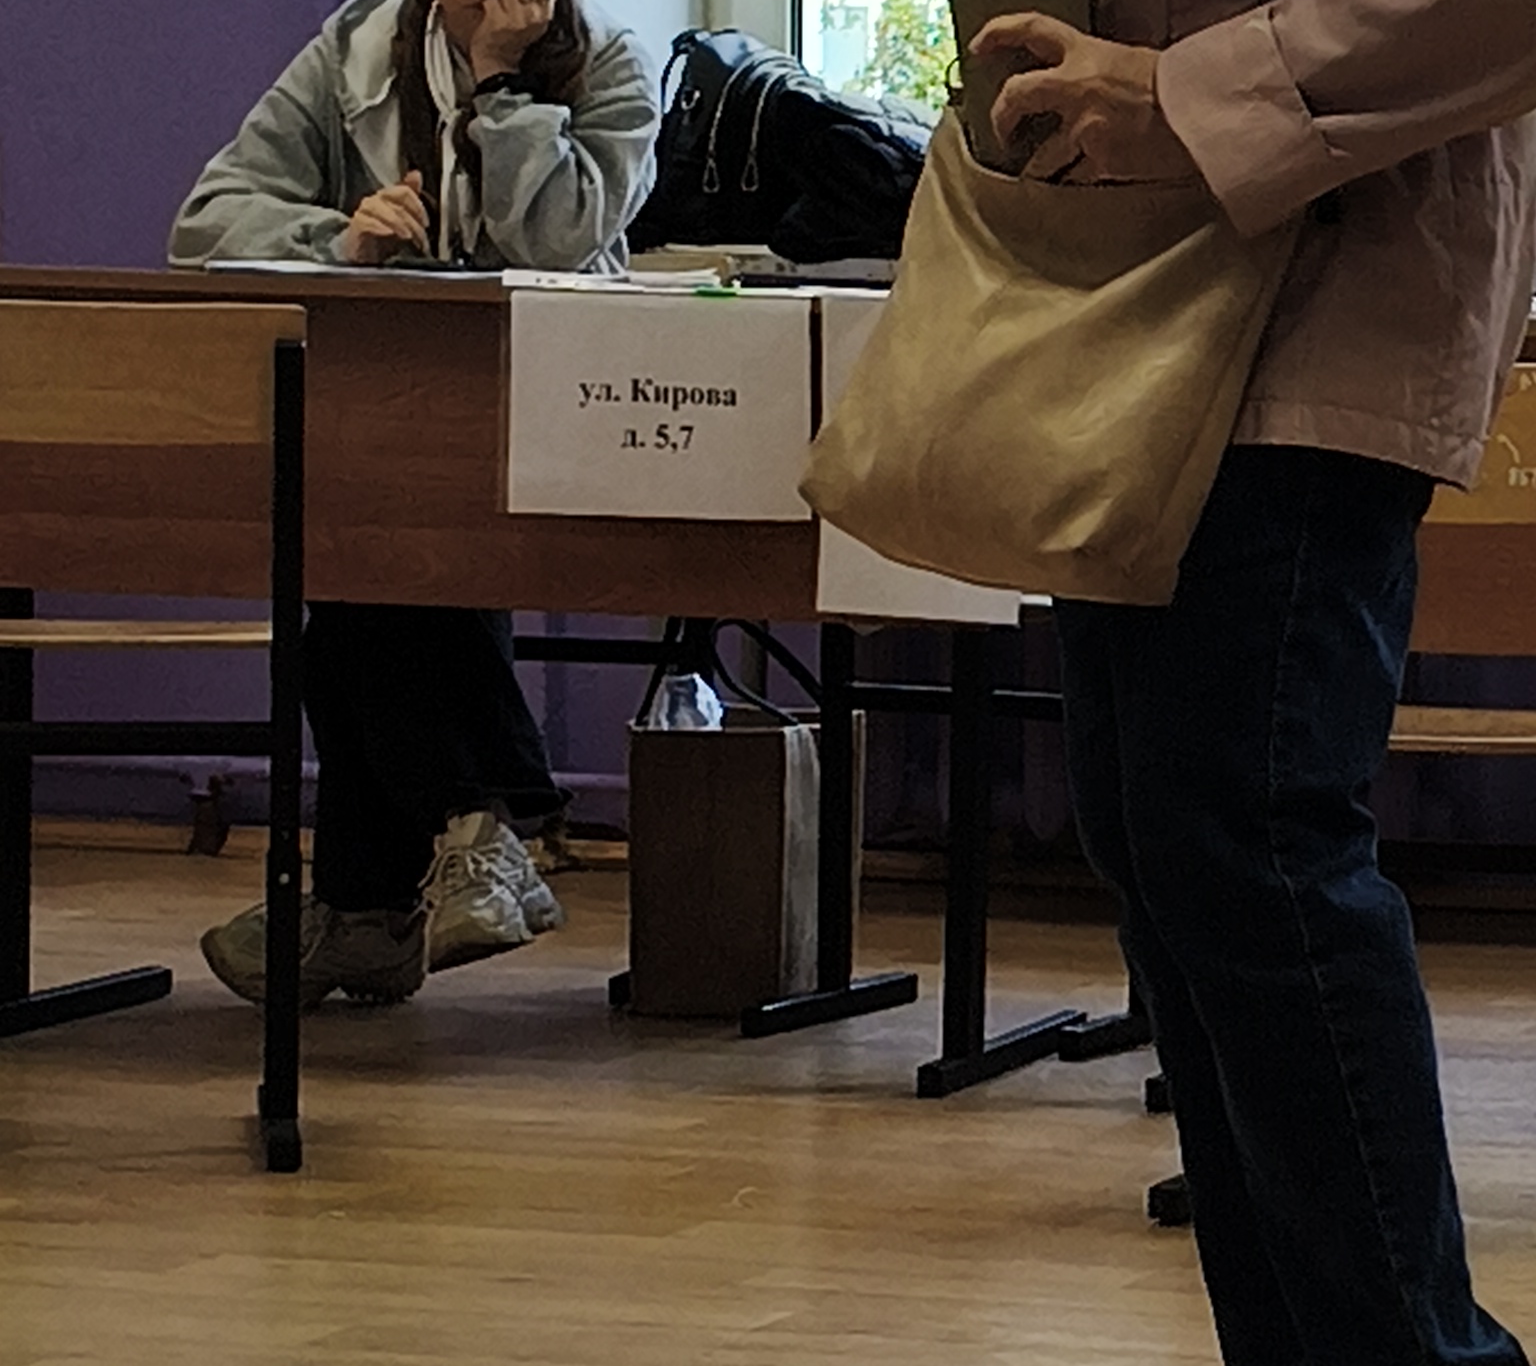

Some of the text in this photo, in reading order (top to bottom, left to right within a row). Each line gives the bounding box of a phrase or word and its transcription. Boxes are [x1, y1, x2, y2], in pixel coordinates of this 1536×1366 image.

[578, 378, 737, 412] ул. Кирова
[620, 424, 695, 453] д. 5,7
